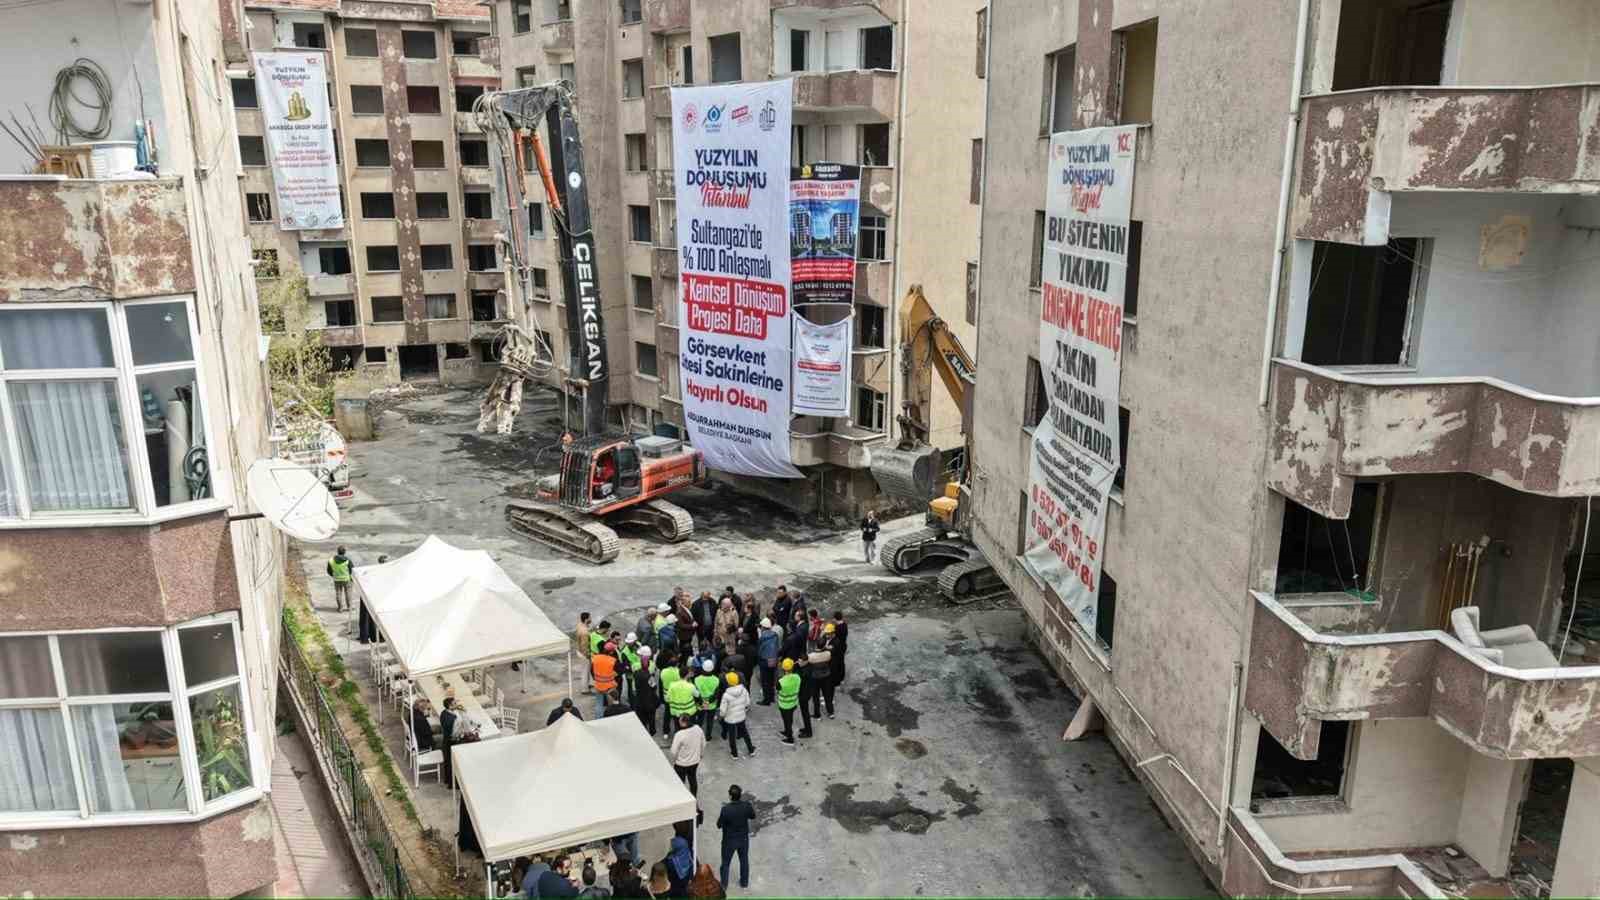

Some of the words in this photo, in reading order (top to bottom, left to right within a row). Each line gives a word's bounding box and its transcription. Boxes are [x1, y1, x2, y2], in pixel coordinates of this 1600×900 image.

[691, 219, 762, 250] Sultangazi'de
[1049, 216, 1066, 243] BU
[1067, 219, 1126, 255] SİTENİN
[683, 245, 694, 270] %
[697, 247, 716, 272] 100
[719, 249, 772, 280] Anlaşmalı
[1059, 252, 1110, 292] YIKIMI
[689, 278, 730, 305] Kentsel
[734, 282, 784, 315] Dönüşüm
[691, 303, 732, 332] Projesi
[735, 310, 763, 336] Daha
[687, 337, 766, 367] Görsevkent
[705, 359, 784, 392] Sakinlerine
[687, 377, 724, 403] Hayırlı
[727, 388, 768, 413] Olsun
[737, 424, 772, 441] DURSUN
